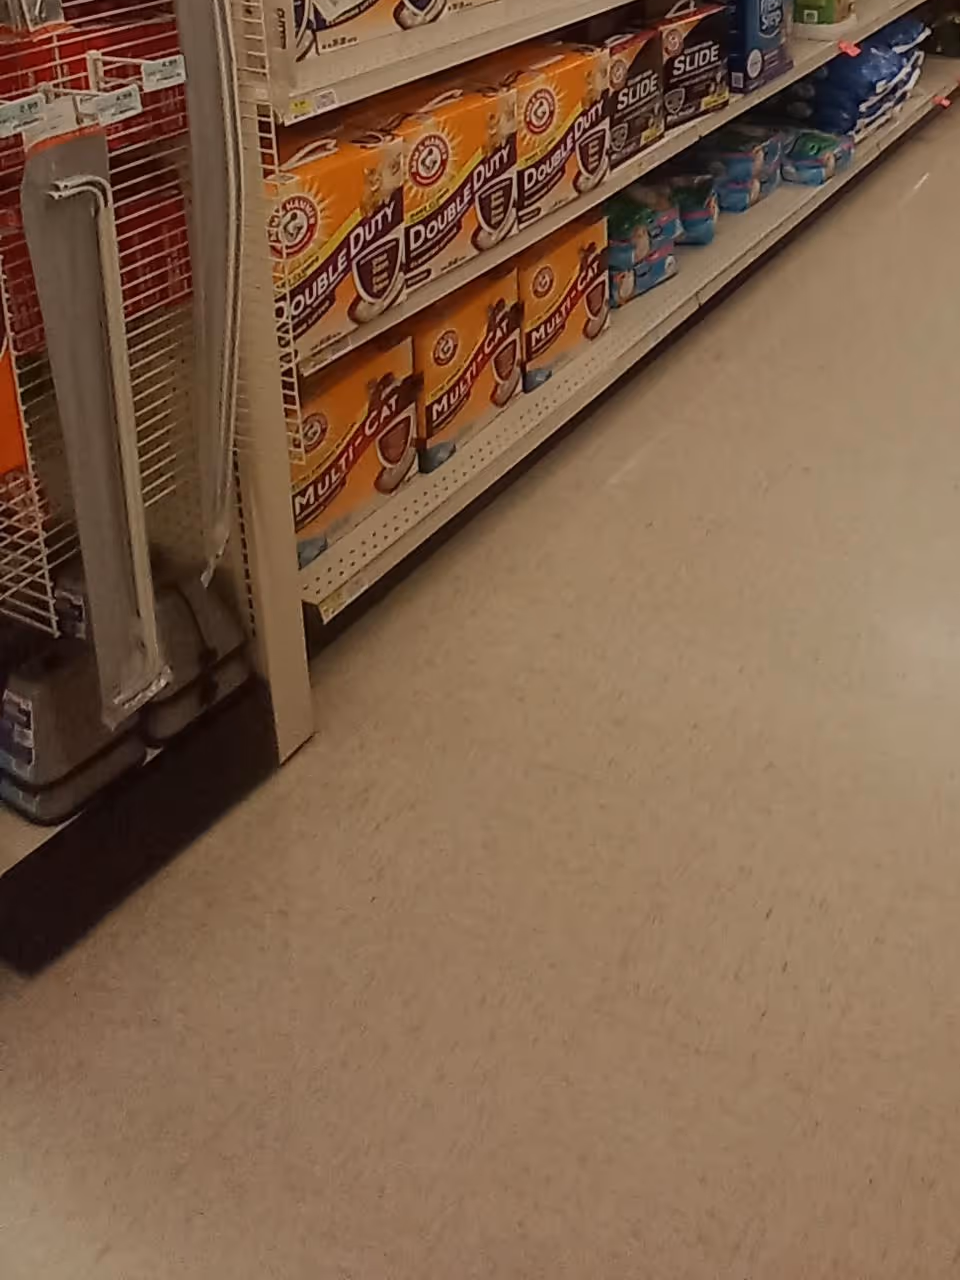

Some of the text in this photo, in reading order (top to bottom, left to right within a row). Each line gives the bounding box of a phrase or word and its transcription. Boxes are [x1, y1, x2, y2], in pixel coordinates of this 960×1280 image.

[617, 73, 659, 111] SLIDE
[672, 44, 720, 76] SLIDE
[524, 99, 604, 191] DOUBLE DUTY
[409, 183, 473, 252] DOUBLE
[473, 143, 510, 193] DUTY
[274, 248, 348, 320] DOUBLE
[350, 200, 395, 258] DUTY
[531, 260, 600, 347] MULTI-CAT
[432, 318, 509, 421] MULTI-CAT
[295, 394, 399, 516] MULTI-CAT
